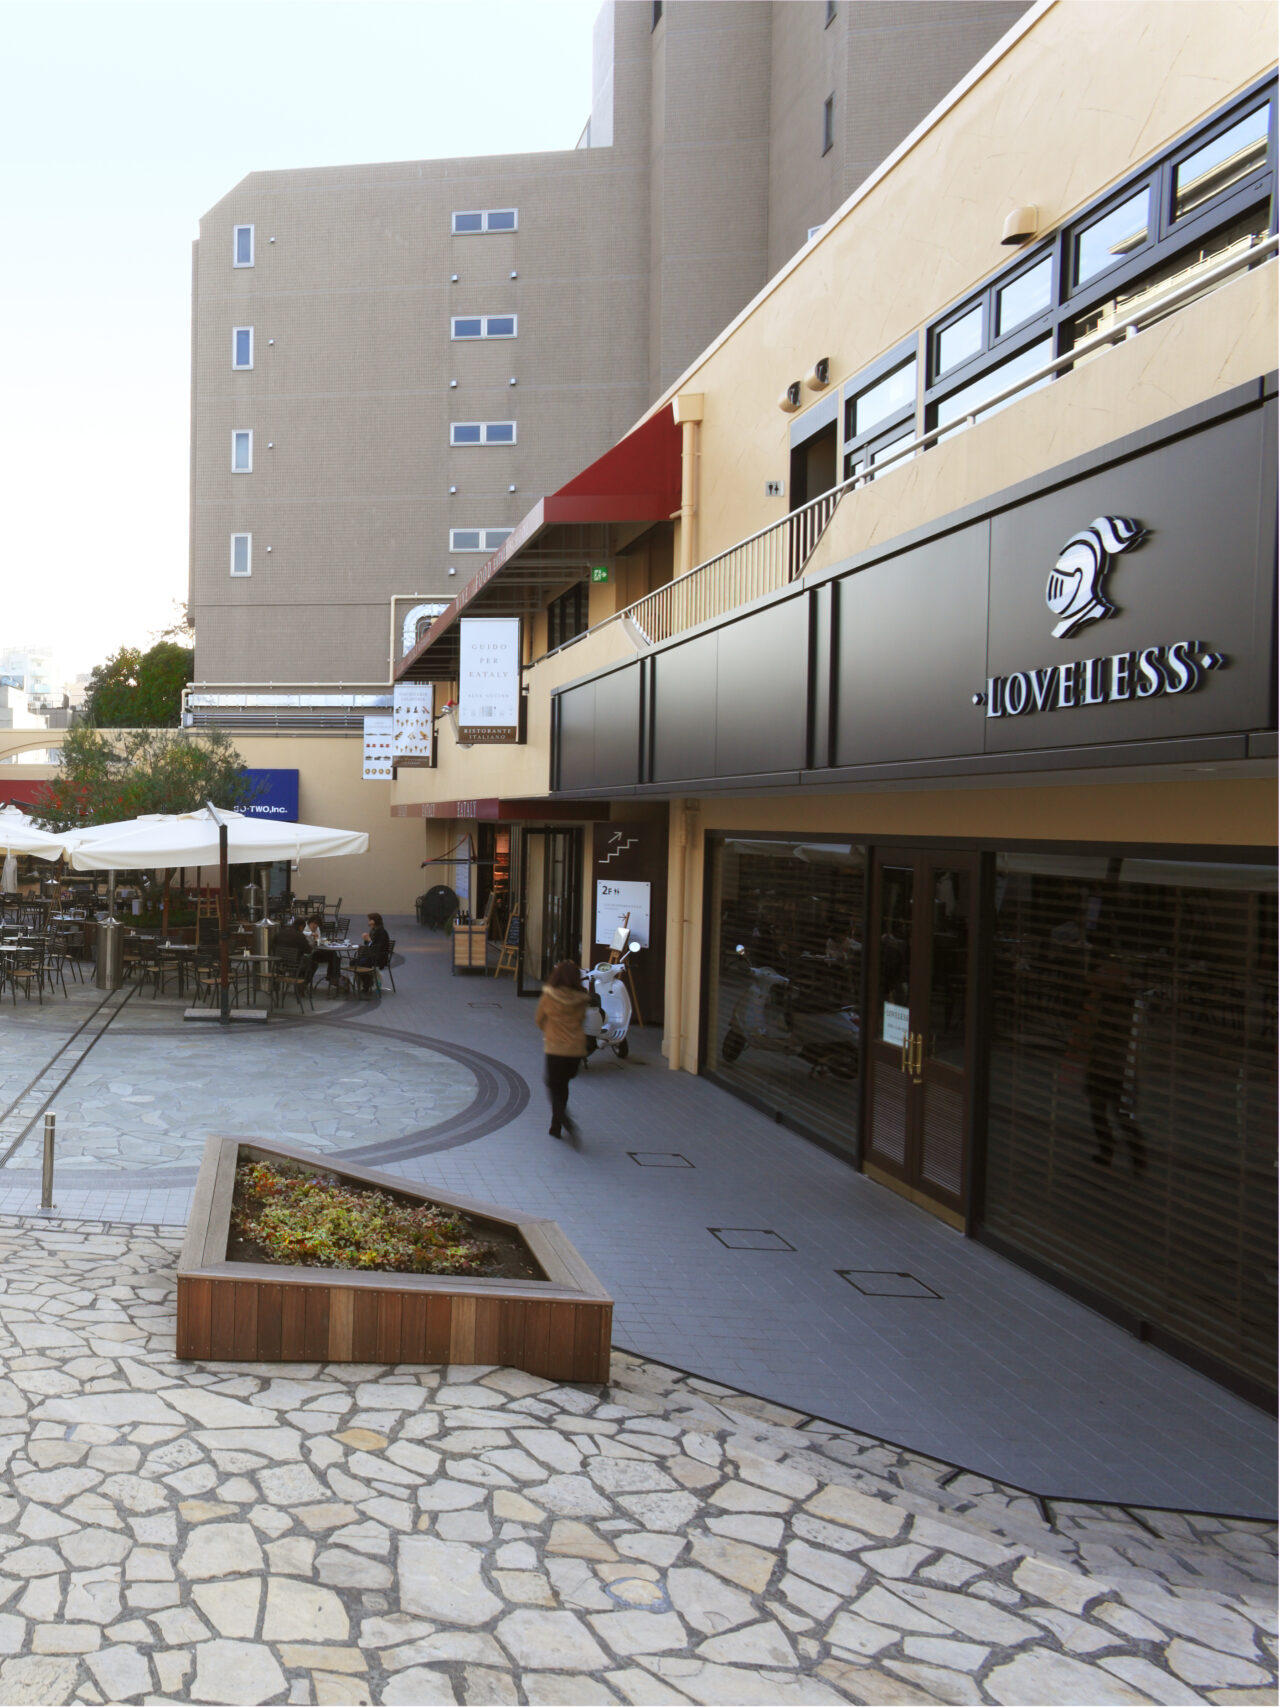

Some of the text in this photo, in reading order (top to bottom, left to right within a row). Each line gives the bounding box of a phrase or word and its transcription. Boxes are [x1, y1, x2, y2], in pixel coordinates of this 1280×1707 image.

[471, 643, 508, 651] GUIDO
[479, 657, 500, 665] PER
[469, 671, 510, 679] EATALY
[985, 641, 1198, 718] LOVELESS
[602, 885, 613, 896] 2F
